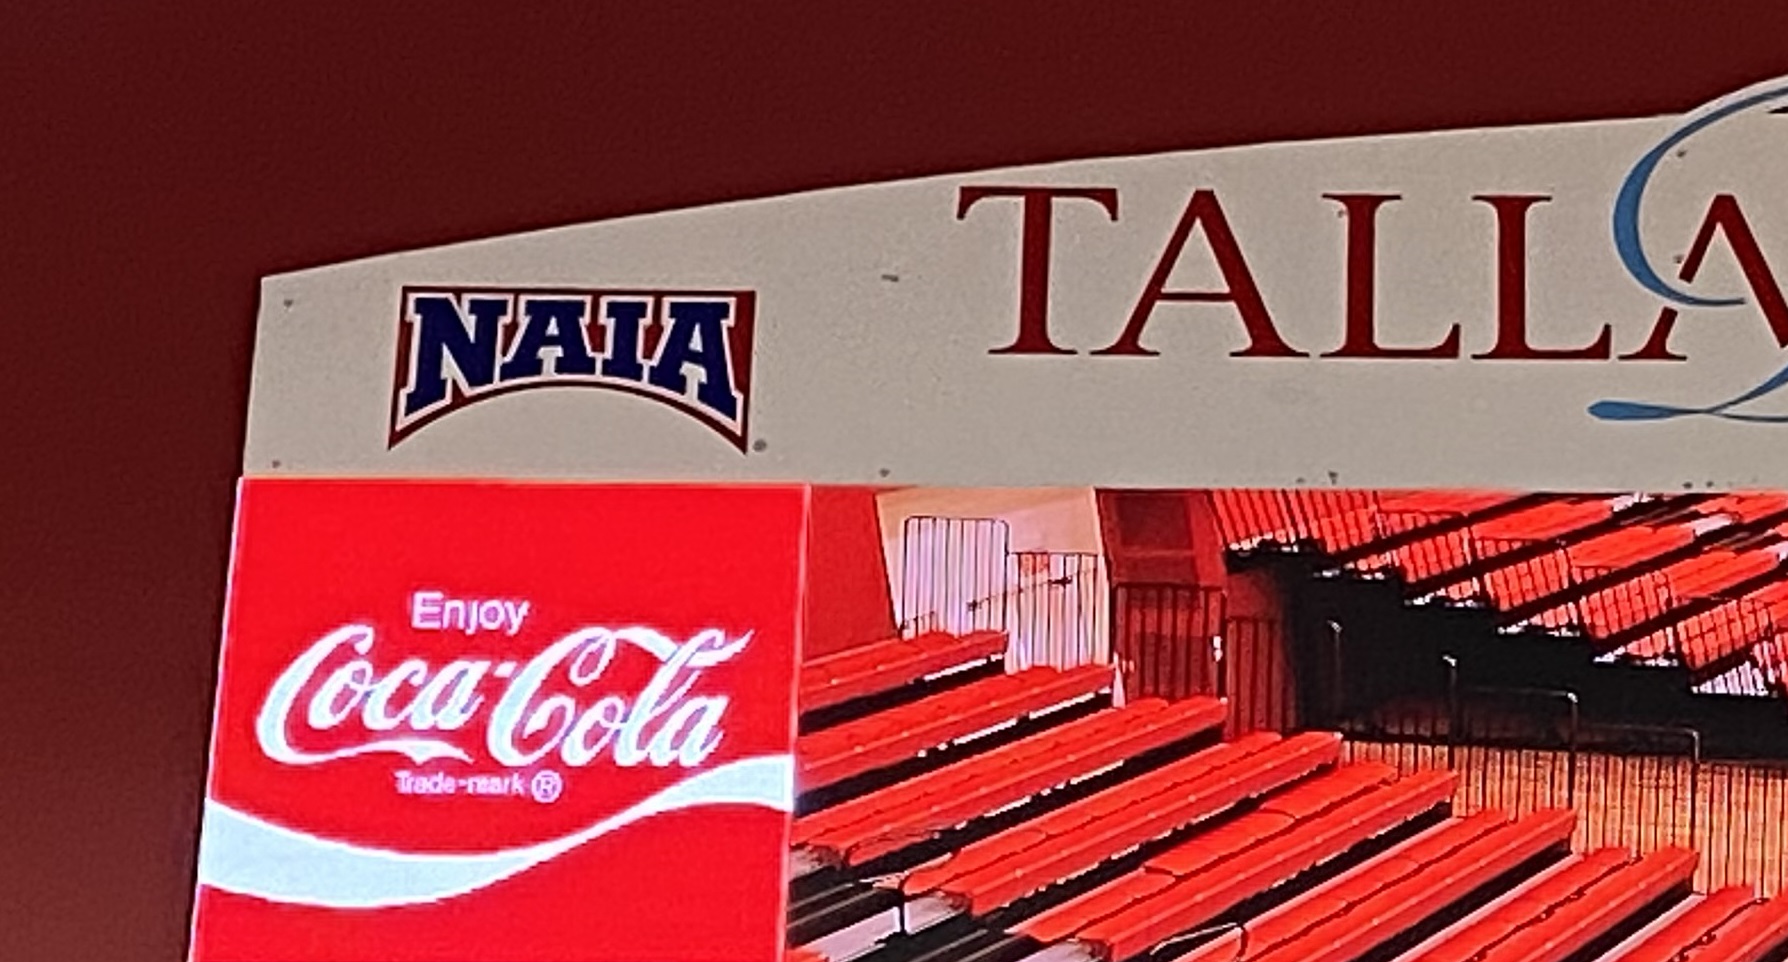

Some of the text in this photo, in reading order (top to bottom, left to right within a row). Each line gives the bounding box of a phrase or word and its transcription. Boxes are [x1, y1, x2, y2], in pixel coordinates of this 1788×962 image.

[395, 290, 748, 436] NAIA
[411, 591, 530, 635] Enjoy
[255, 623, 756, 768] Coca-Cola
[395, 770, 525, 794] Trade-mark
